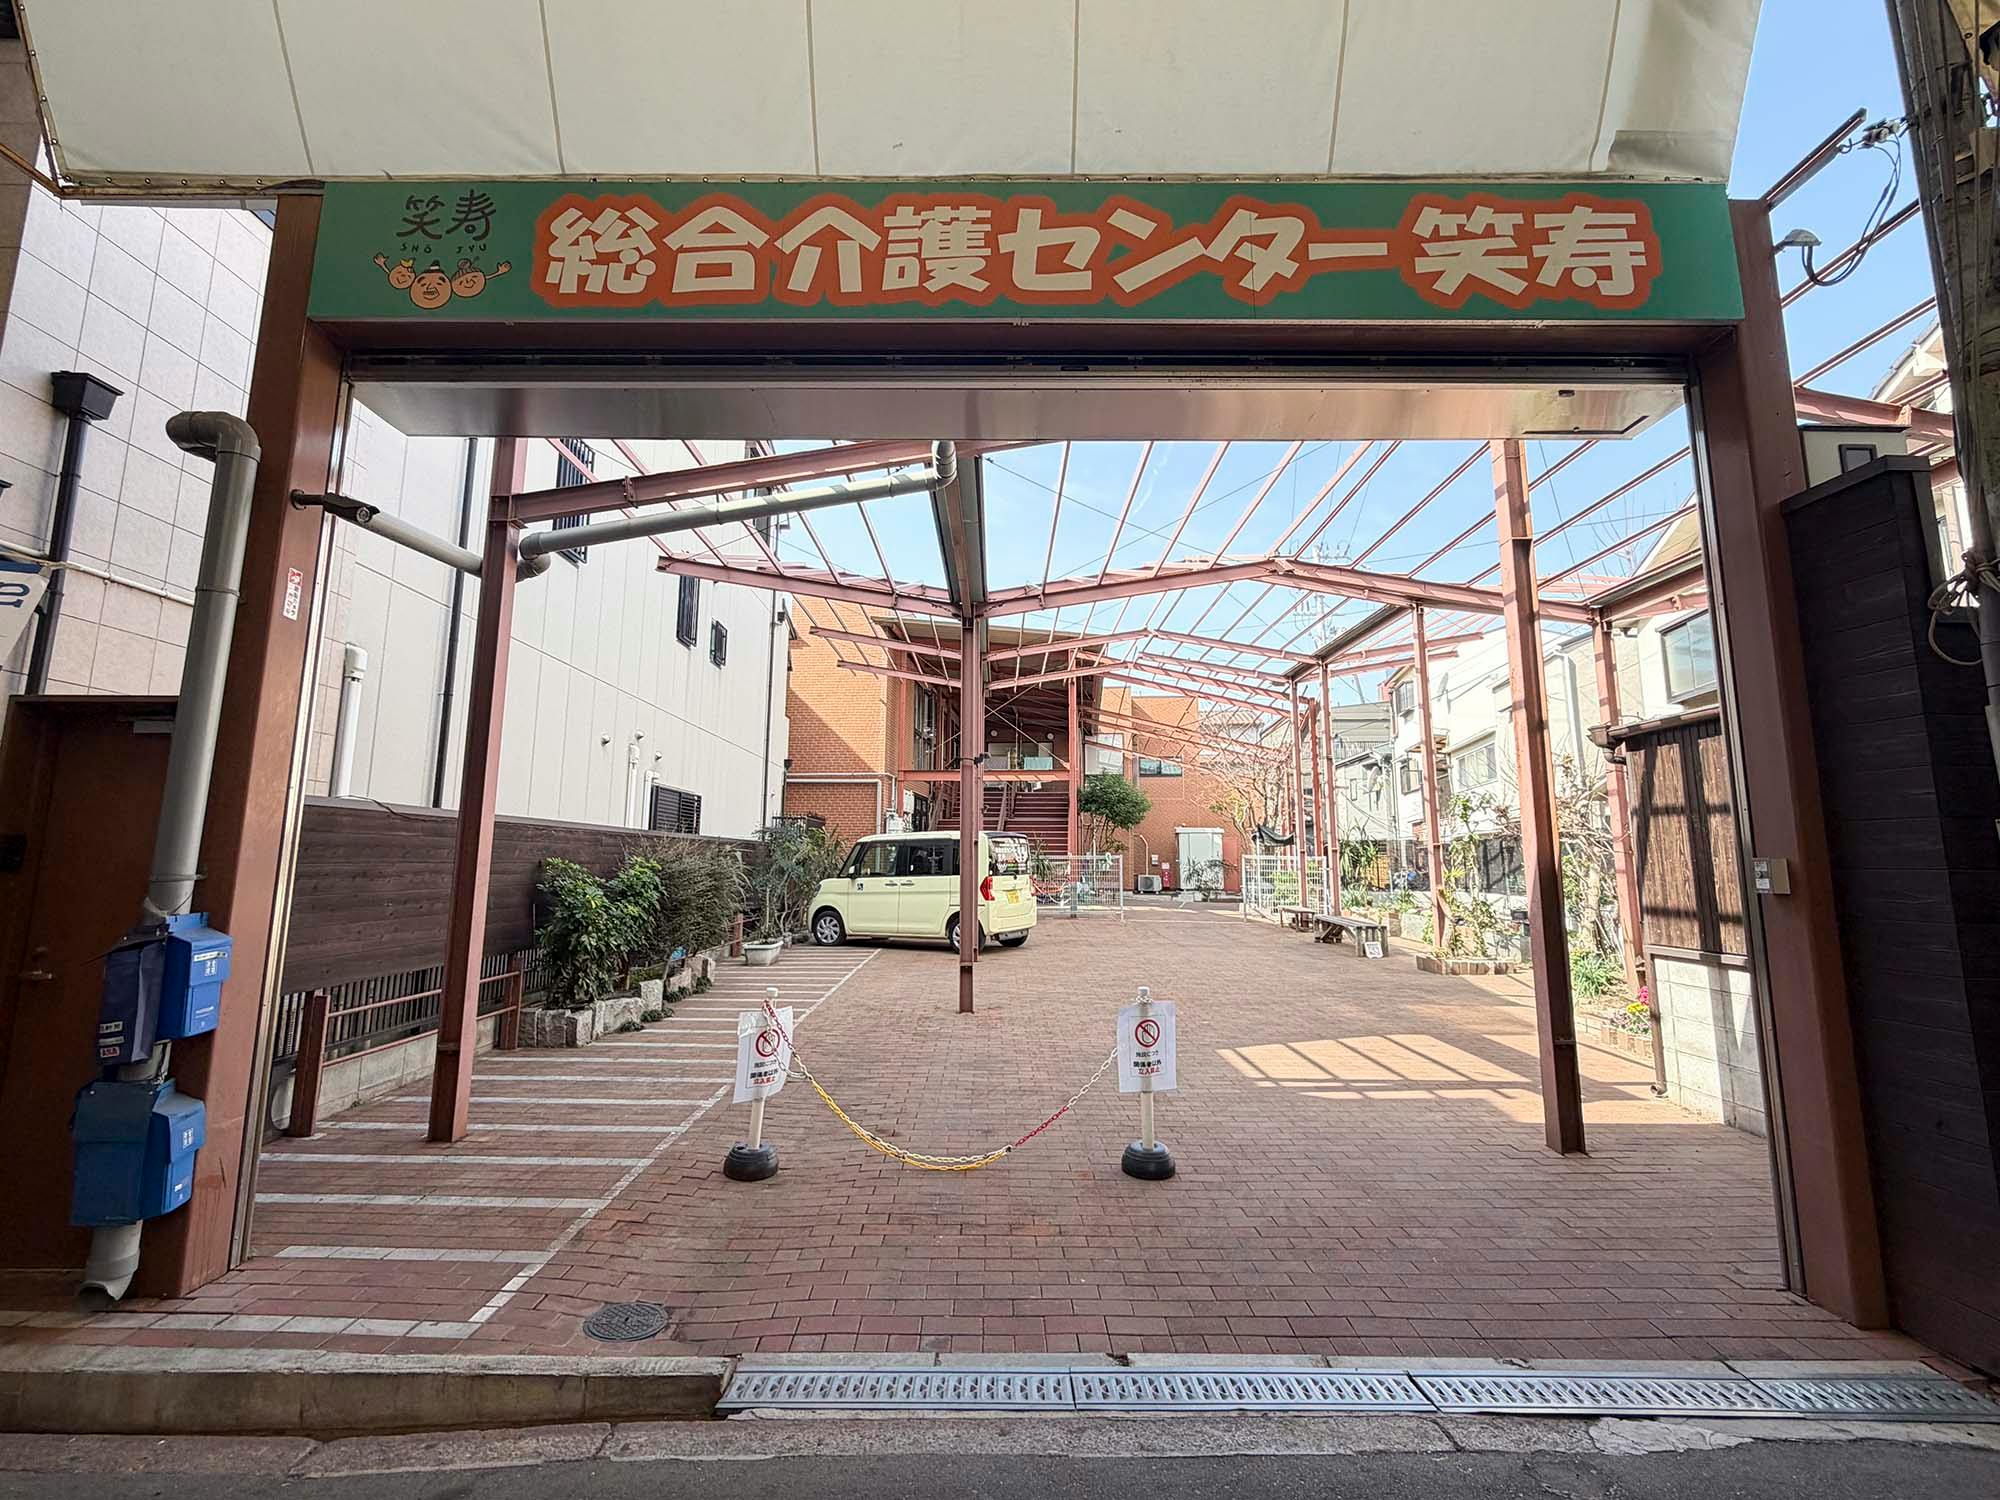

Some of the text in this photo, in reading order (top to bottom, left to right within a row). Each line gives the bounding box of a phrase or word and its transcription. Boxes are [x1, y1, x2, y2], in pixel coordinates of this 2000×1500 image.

[396, 189, 496, 240] 笑寿
[456, 243, 487, 254] JYU
[545, 204, 1646, 295] 総合介護センター笑寿
